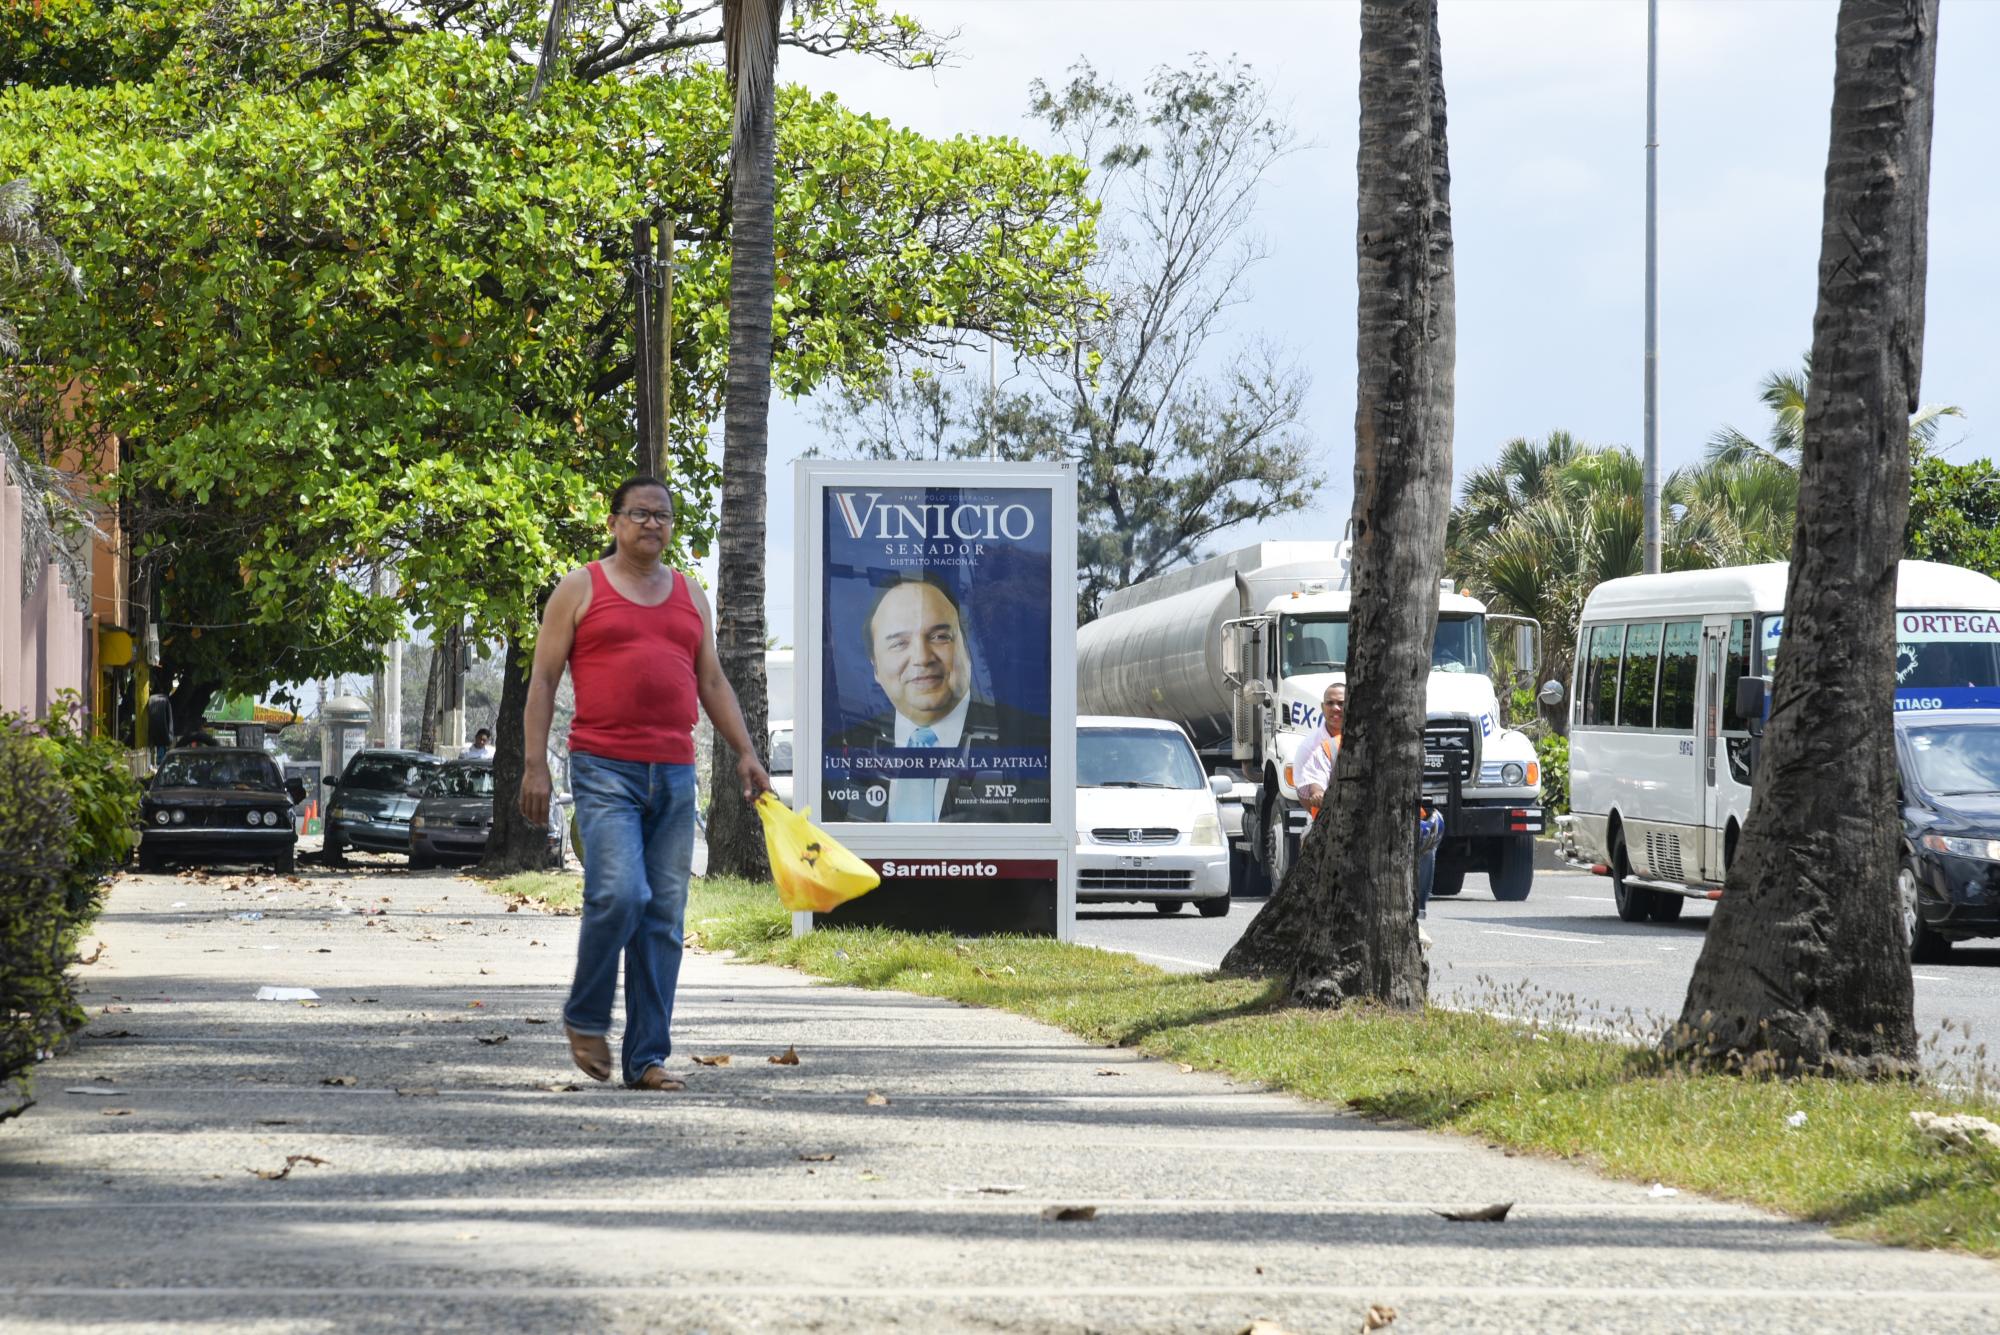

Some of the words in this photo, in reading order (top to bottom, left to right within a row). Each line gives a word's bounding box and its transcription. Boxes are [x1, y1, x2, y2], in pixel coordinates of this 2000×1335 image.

[835, 492, 1035, 541] VINICIO
[885, 543, 985, 555] SENADOR
[890, 558, 931, 567] DISTRITO
[933, 558, 980, 567] NACIONAL
[1903, 615, 2000, 633] ORTEGA
[825, 755, 852, 769] ¡UN
[855, 757, 925, 769] SENADOR
[929, 757, 966, 769] PARA
[970, 757, 988, 768] LA
[993, 755, 1048, 769] PATRIA!
[827, 787, 860, 801] vota
[867, 789, 884, 802] 10
[984, 784, 1017, 798] FNP
[881, 860, 998, 877] Sarmiento
